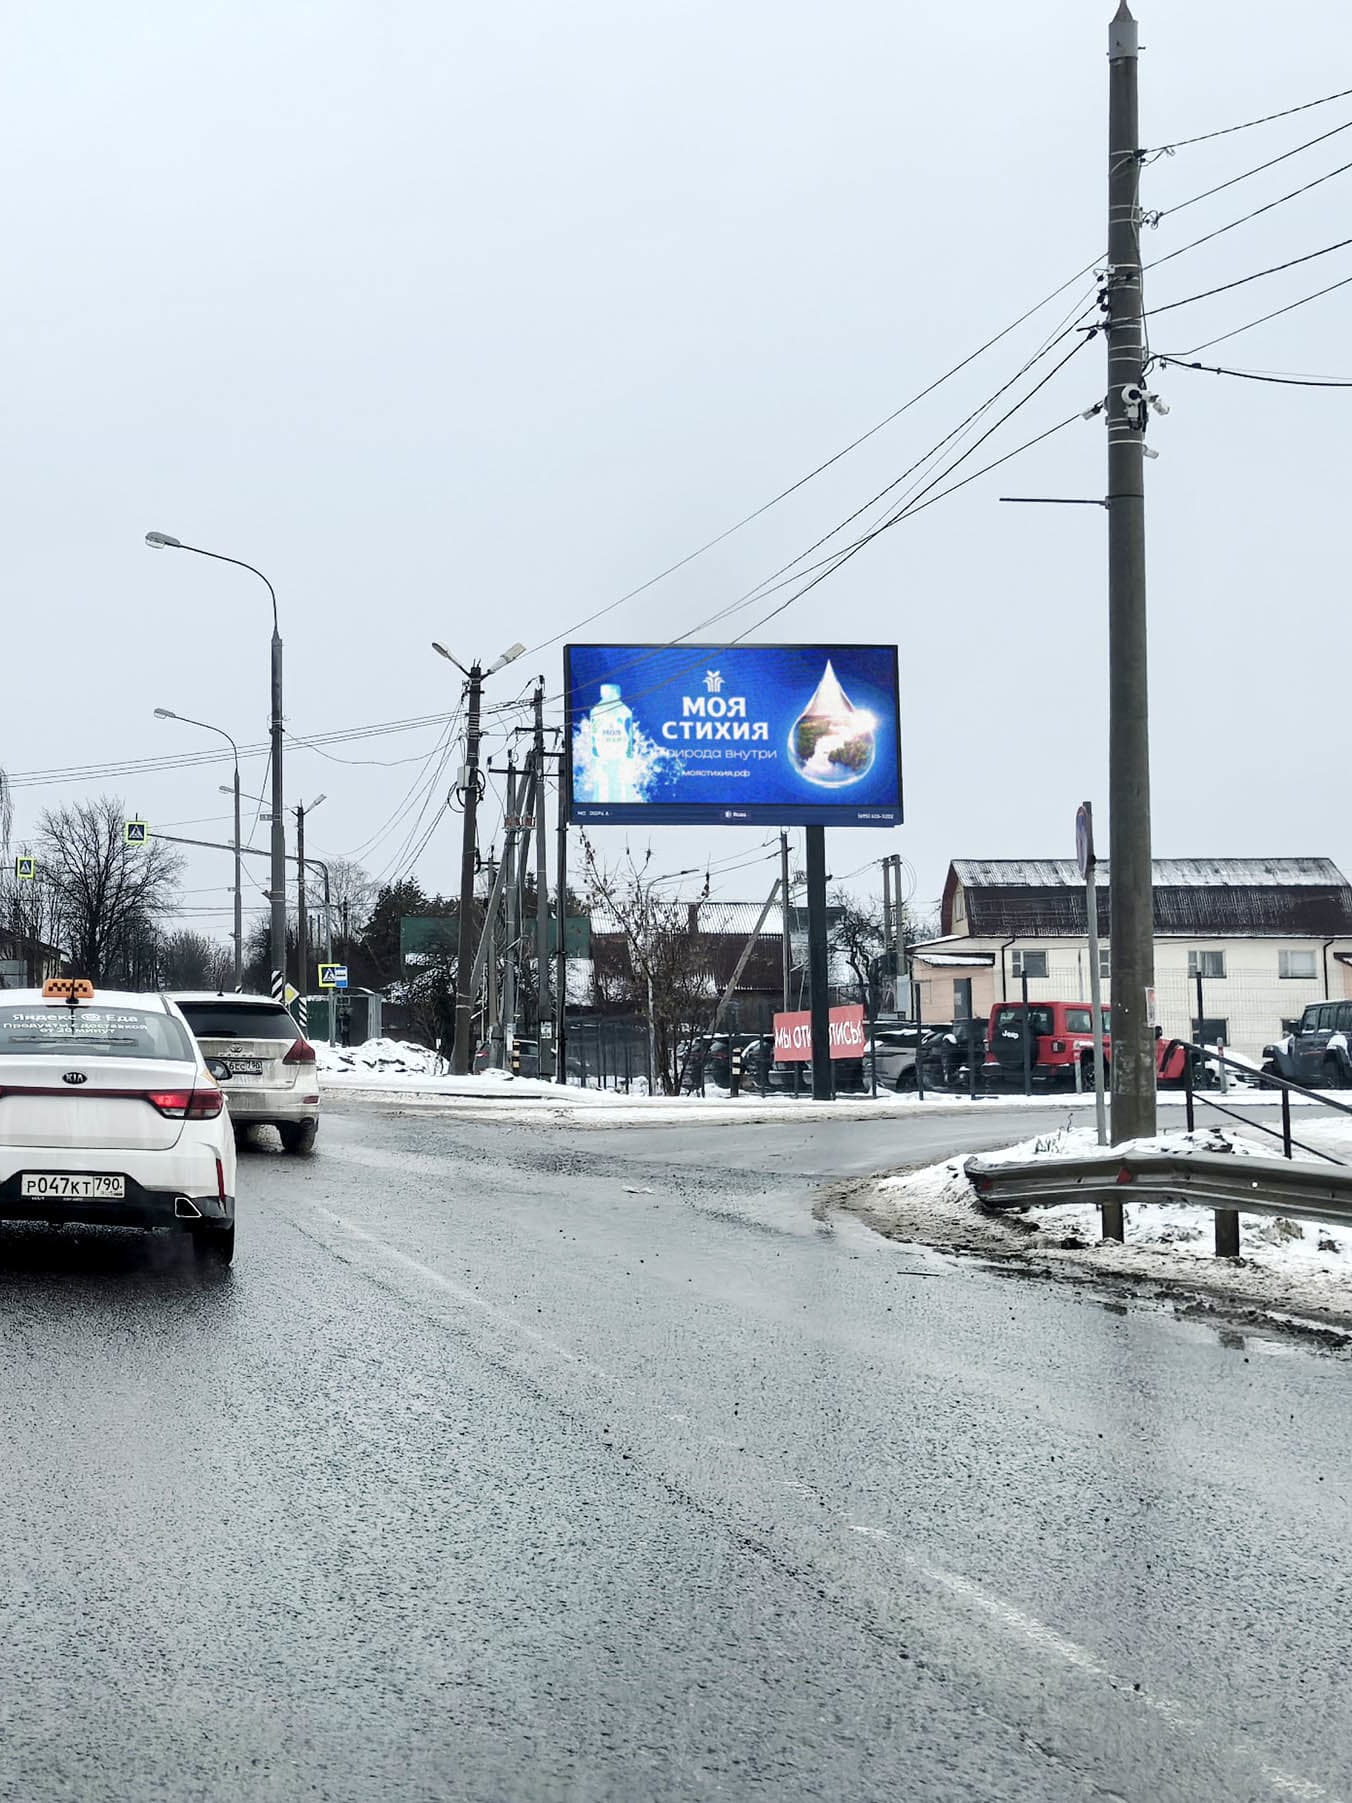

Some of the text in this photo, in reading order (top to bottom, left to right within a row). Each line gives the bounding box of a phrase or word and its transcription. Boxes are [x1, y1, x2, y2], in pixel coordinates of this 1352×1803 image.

[682, 695, 746, 718] МОЯ
[661, 720, 769, 740] СТИХИЯ
[725, 749, 777, 760] внутри
[12, 1013, 138, 1022] Яндекс Еда
[775, 1025, 791, 1048] МЫ
[65, 1073, 84, 1083] KIA
[95, 1177, 120, 1191] 790
